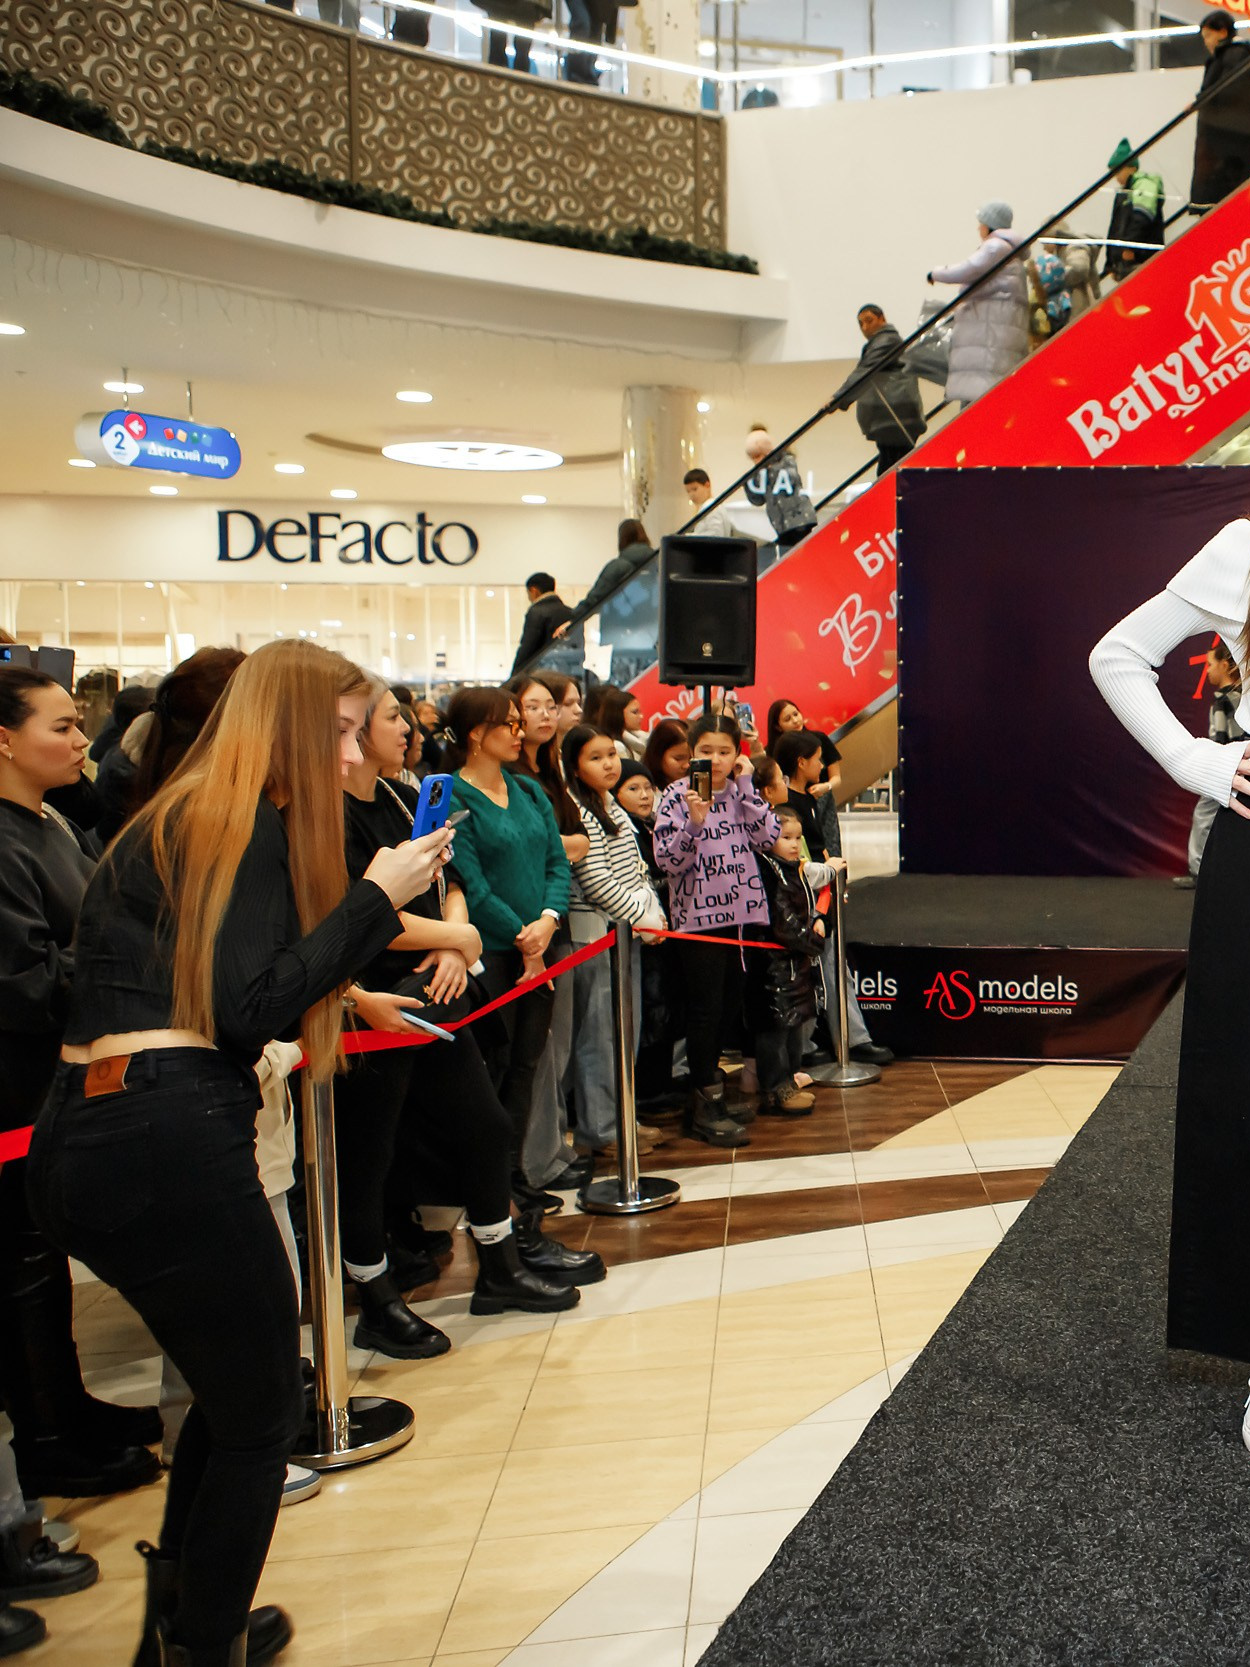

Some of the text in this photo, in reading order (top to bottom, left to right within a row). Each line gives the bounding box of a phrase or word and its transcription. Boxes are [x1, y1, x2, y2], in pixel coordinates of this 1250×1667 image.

[1066, 333, 1211, 459] Batyr
[113, 430, 126, 450] 2
[216, 509, 480, 567] DeFacto
[704, 863, 746, 882] PARIS
[978, 974, 1079, 1001] models
[860, 1002, 892, 1011] школа
[983, 1004, 1072, 1015] модельная школа
